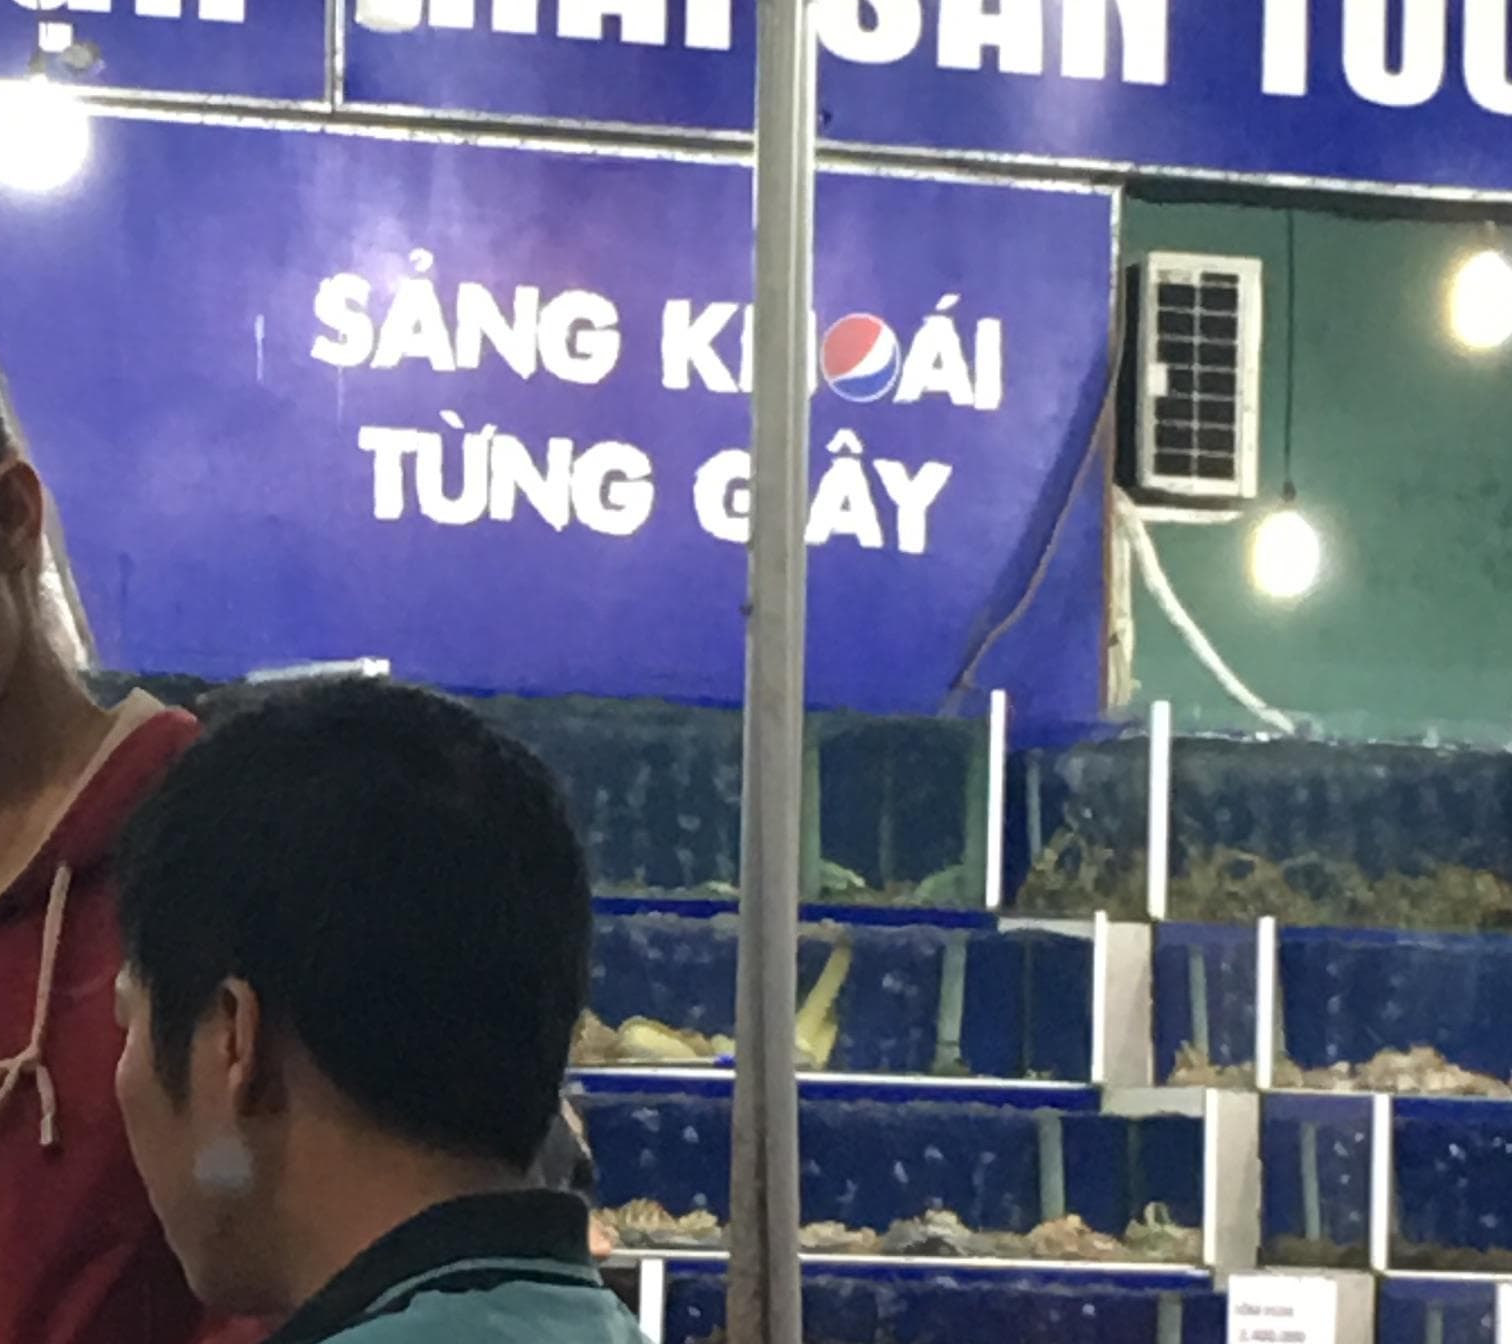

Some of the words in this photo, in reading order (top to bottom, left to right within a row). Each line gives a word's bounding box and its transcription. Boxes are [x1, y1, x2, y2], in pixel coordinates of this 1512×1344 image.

[310, 247, 621, 384] SẢNG
[357, 410, 654, 536] TỪNG
[693, 428, 953, 555] GÂY
